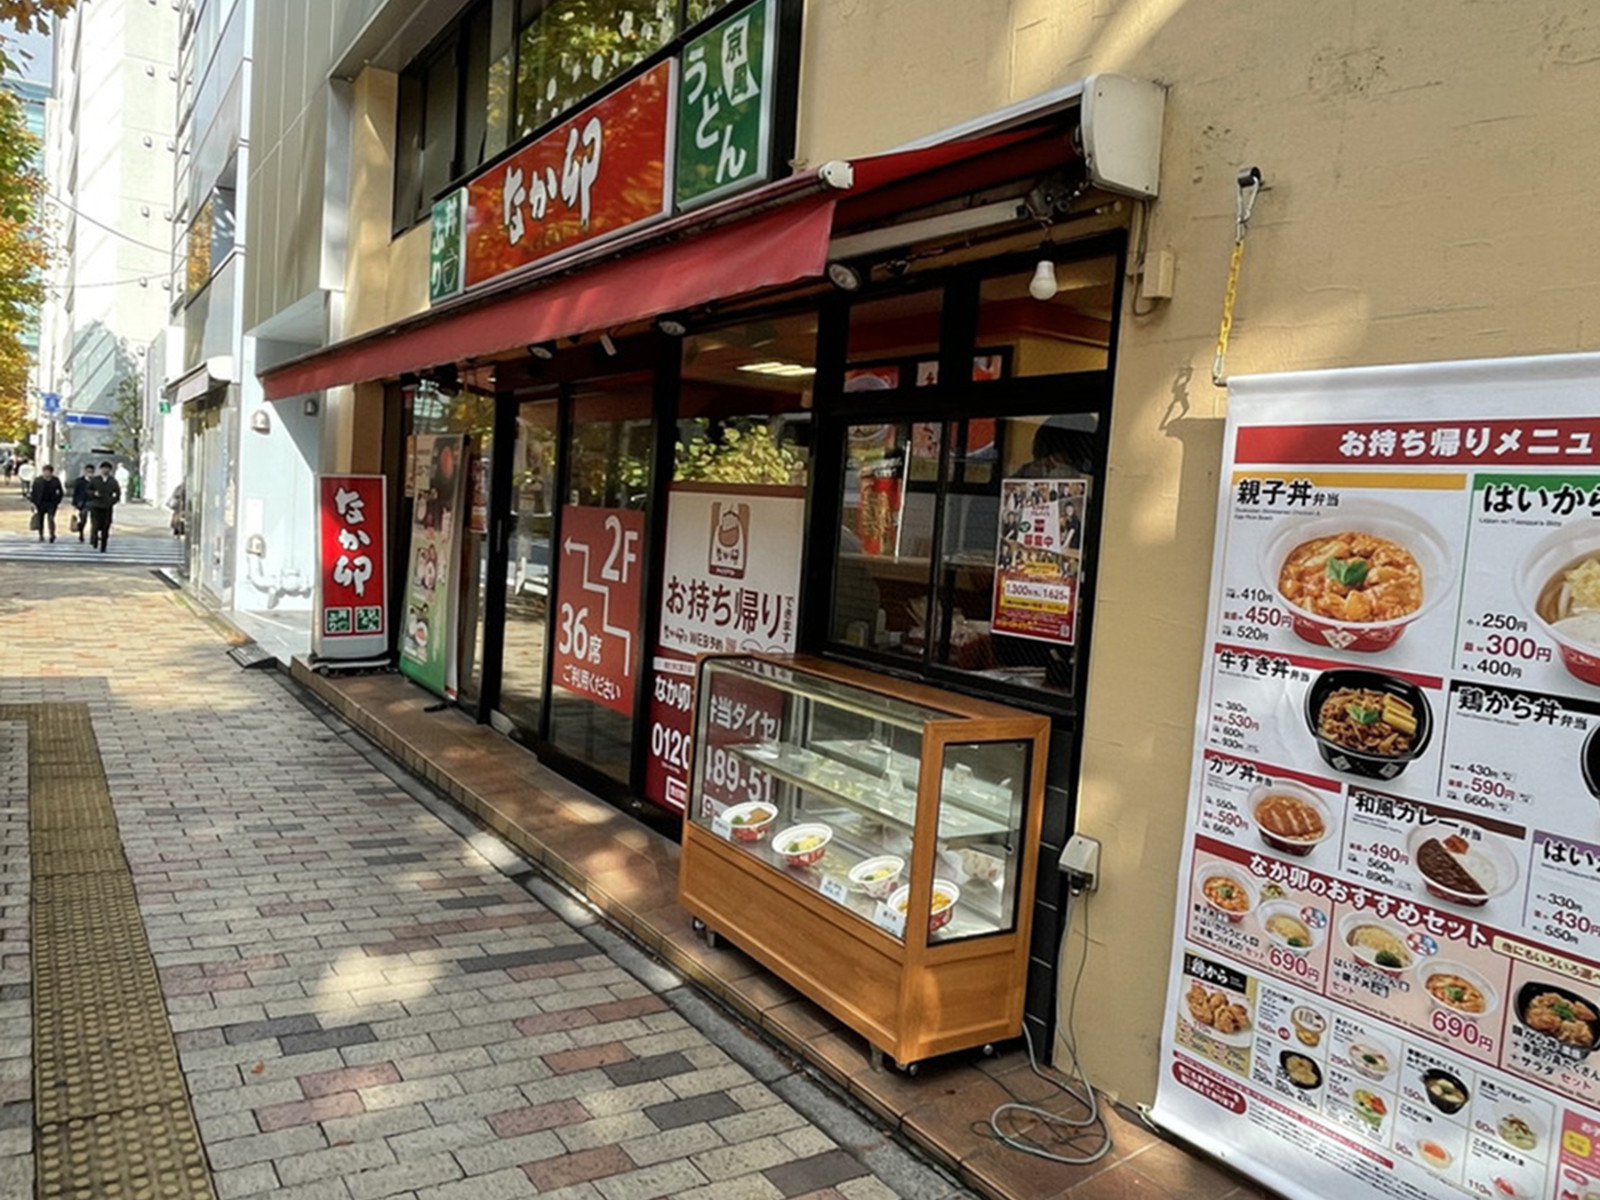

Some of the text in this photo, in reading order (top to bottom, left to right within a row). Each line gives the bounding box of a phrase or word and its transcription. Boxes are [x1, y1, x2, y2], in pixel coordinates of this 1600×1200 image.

[684, 46, 748, 184] うどん
[503, 116, 601, 246] なか卯
[1339, 426, 1593, 458] お持ち帰りメニュ
[1236, 478, 1340, 507] 親子丼弁当
[334, 487, 373, 598] なか卯
[601, 514, 639, 583] 2F
[665, 575, 782, 639] お持ち帰り
[1241, 587, 1273, 603] 410円
[1245, 606, 1292, 628] 450円
[1482, 612, 1528, 632] 250円
[558, 602, 603, 665] 36席
[1237, 625, 1269, 641] 520円
[1486, 633, 1552, 663] 300円
[562, 664, 622, 700] ご利用ください
[1476, 659, 1522, 679] 400円
[1228, 712, 1260, 731] 530円
[1467, 763, 1498, 779] 430円
[1463, 793, 1495, 810] 660円
[1471, 777, 1516, 801] 590円
[1218, 810, 1249, 831] 590円
[1369, 842, 1410, 865] 490円
[1544, 839, 1600, 873] はい
[1249, 854, 1488, 948] なか卯のおすすめセット
[1547, 892, 1583, 913] 330円
[1544, 924, 1579, 945] 550円
[1269, 946, 1320, 982] 690円
[1431, 1010, 1493, 1052] 690円
[1560, 1072, 1592, 1092] セット
